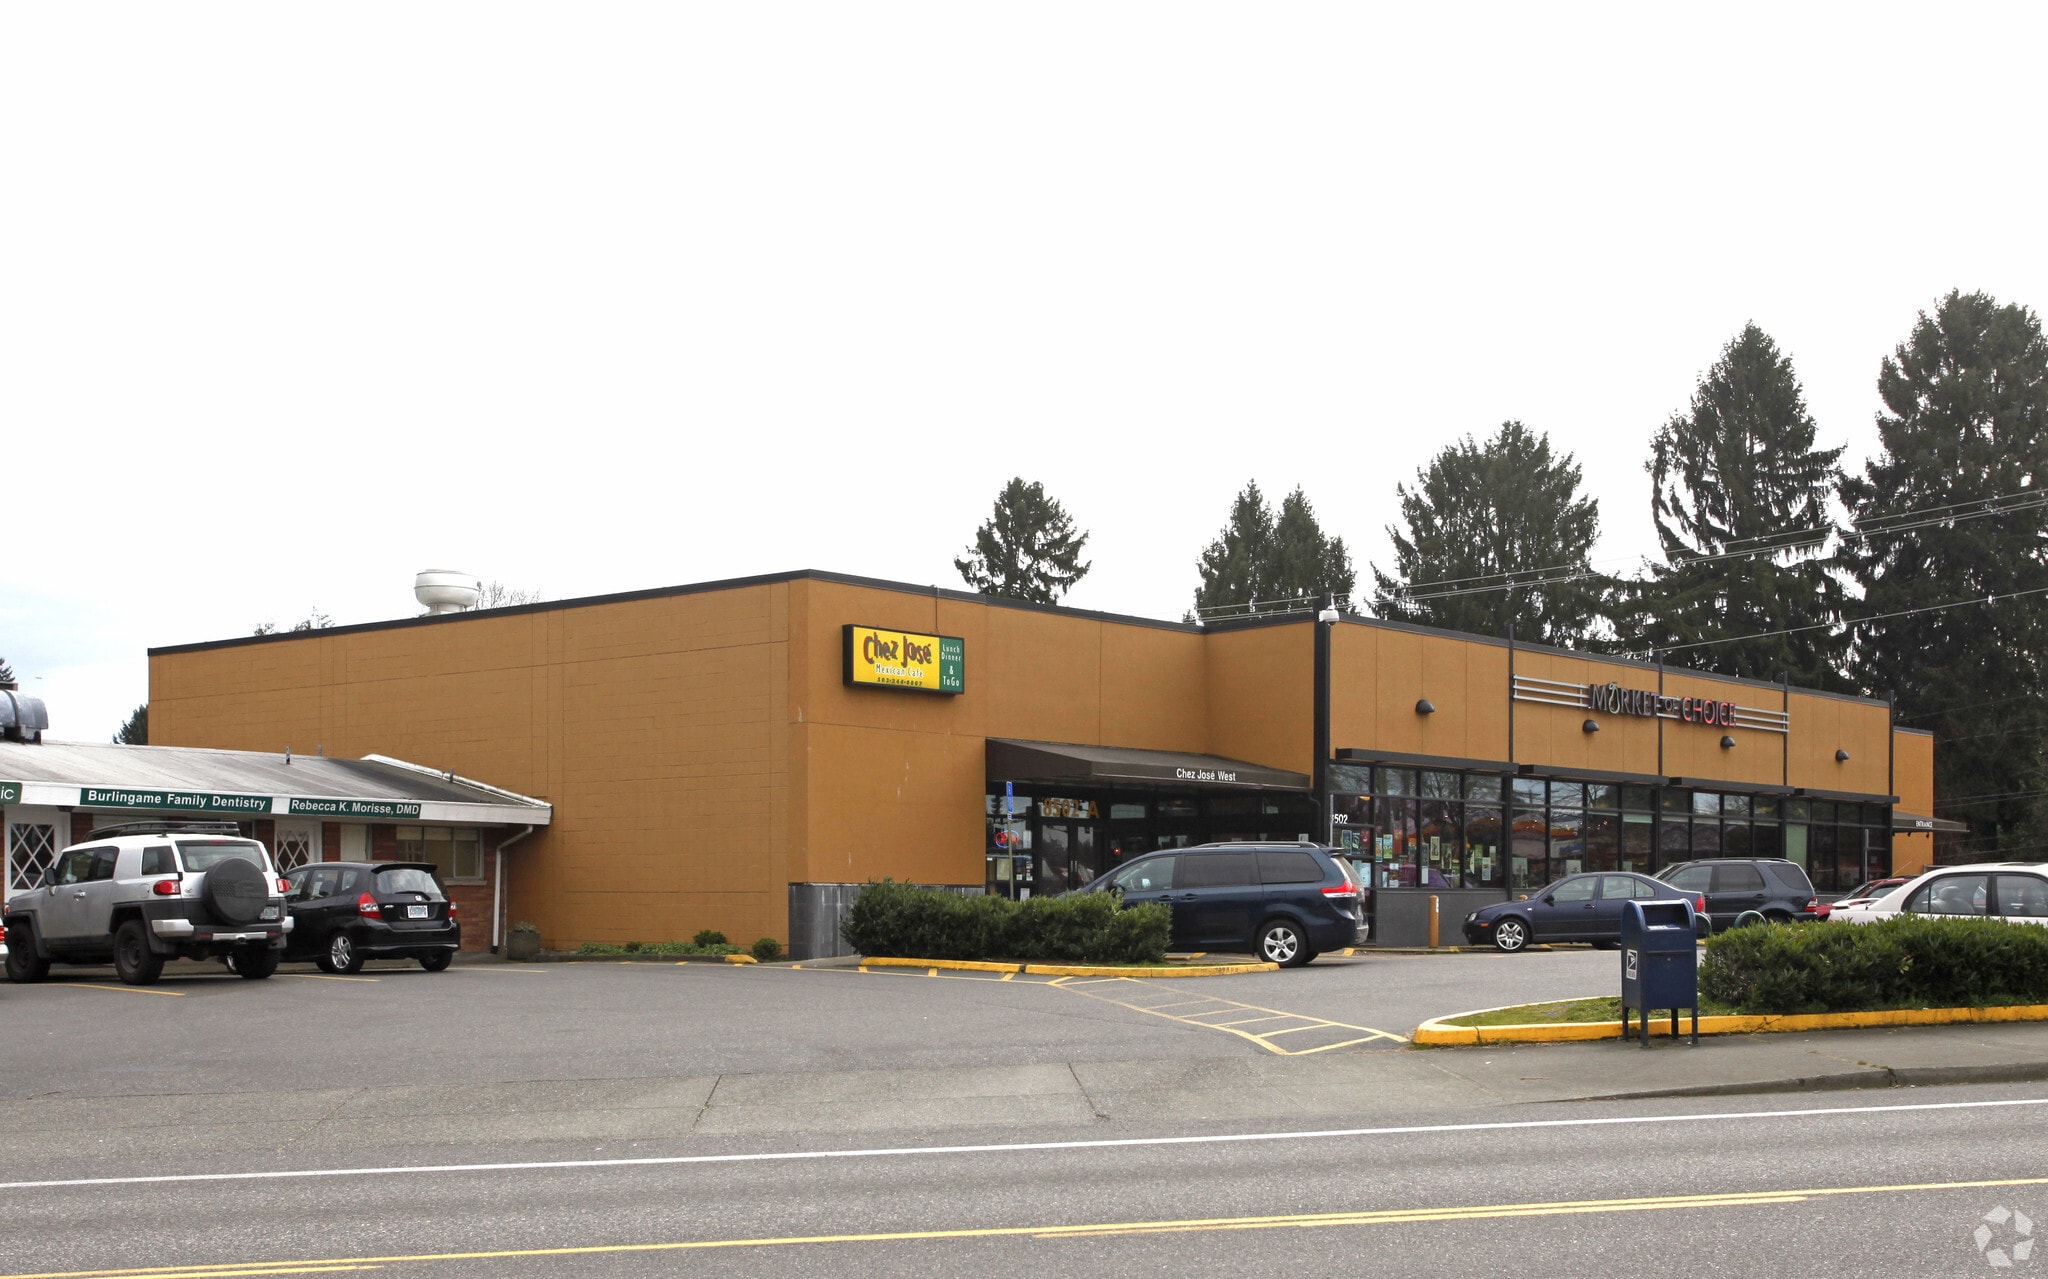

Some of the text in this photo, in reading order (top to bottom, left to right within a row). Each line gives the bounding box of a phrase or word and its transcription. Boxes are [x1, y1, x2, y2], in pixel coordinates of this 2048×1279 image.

[864, 632, 898, 664] Chez
[942, 644, 960, 653] Lunch
[941, 652, 961, 662] Dinner
[876, 664, 924, 678] Mexican Cafe
[949, 665, 954, 675] &
[1683, 697, 1735, 726] CHOICE
[1176, 768, 1236, 781] Chez José West
[88, 790, 266, 810] Burlingame Family Dentistry
[291, 799, 419, 815] Rebecca K. Morisse, DMD
[1043, 798, 1100, 819] 8502 A
